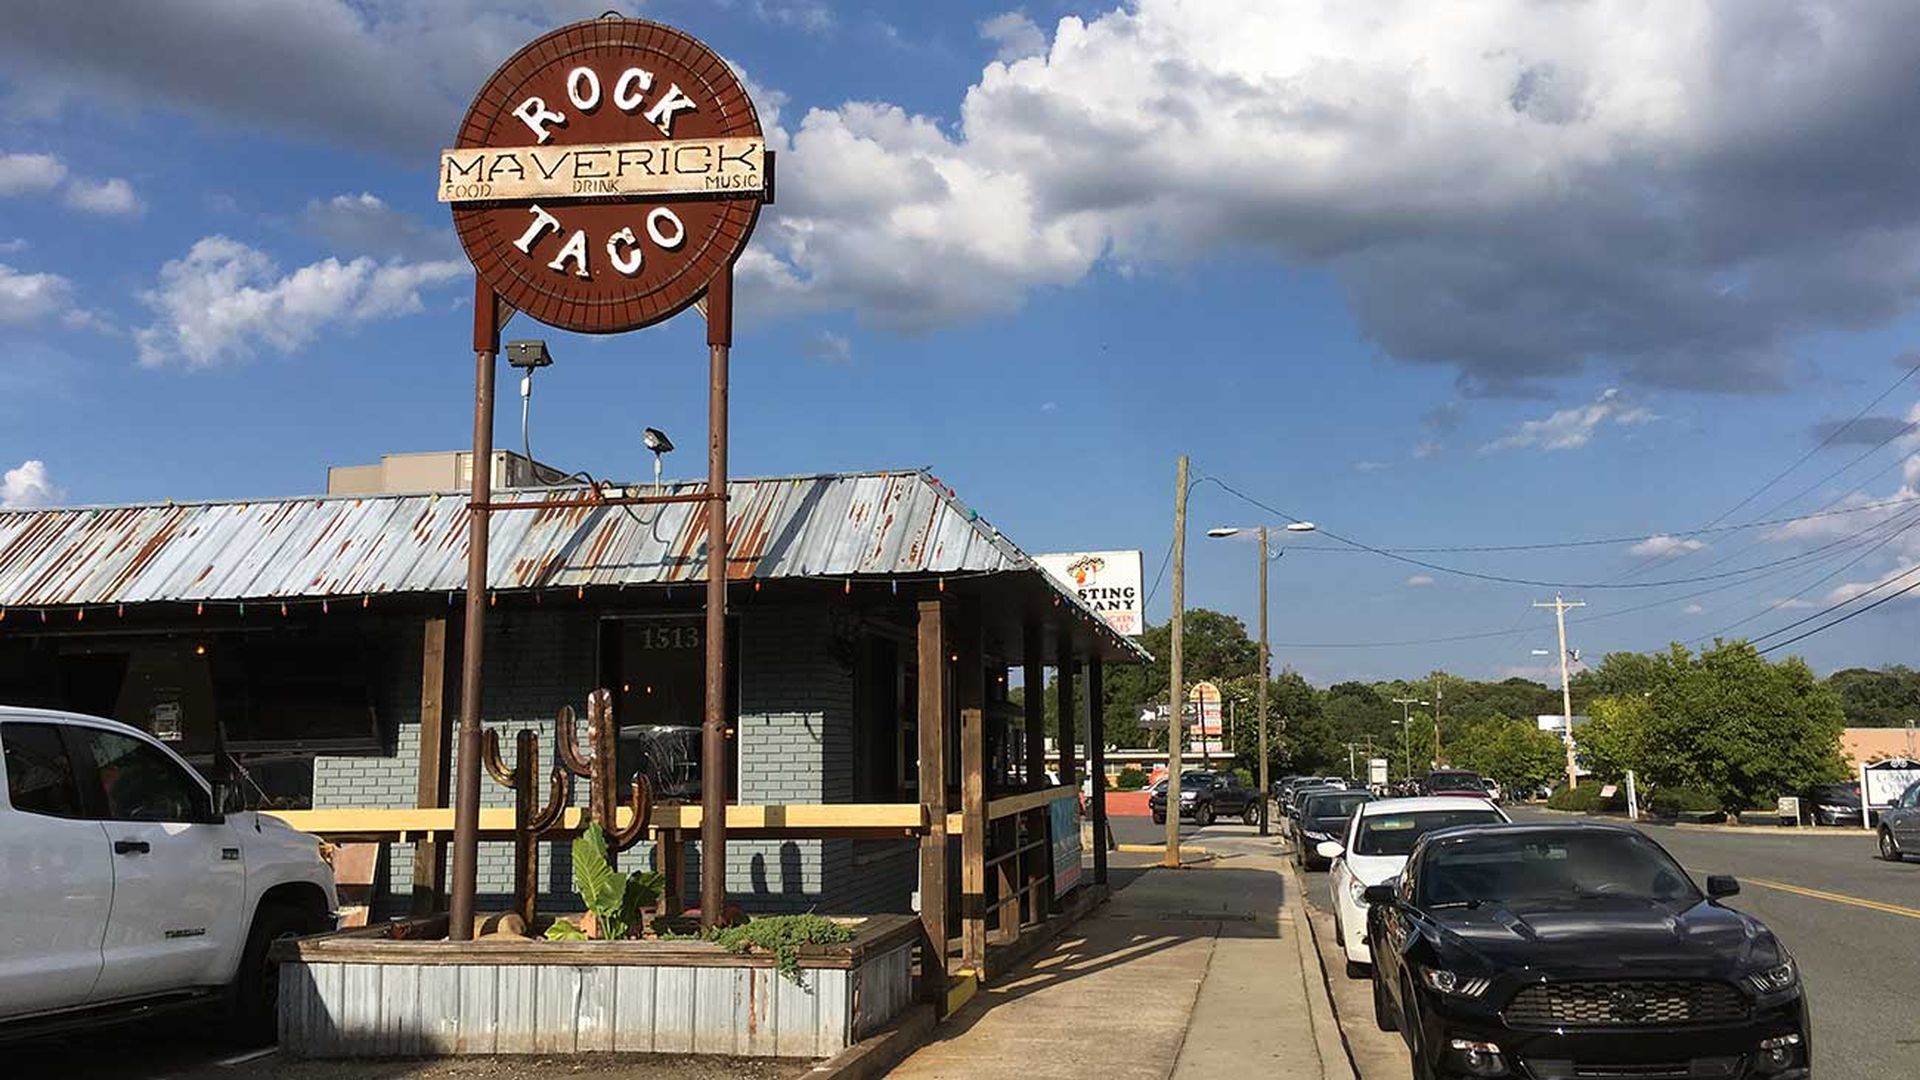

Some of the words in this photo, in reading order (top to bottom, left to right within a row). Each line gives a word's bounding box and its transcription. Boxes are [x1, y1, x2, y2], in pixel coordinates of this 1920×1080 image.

[512, 66, 697, 144] ROCK
[445, 143, 758, 183] MAVERICK
[446, 184, 492, 198] FOOD
[572, 179, 620, 193] DRINK
[705, 174, 758, 190] MUSIC
[513, 204, 684, 277] TACO
[1078, 587, 1135, 601] STING
[1085, 600, 1135, 611] ANY
[641, 626, 699, 649] 1513
